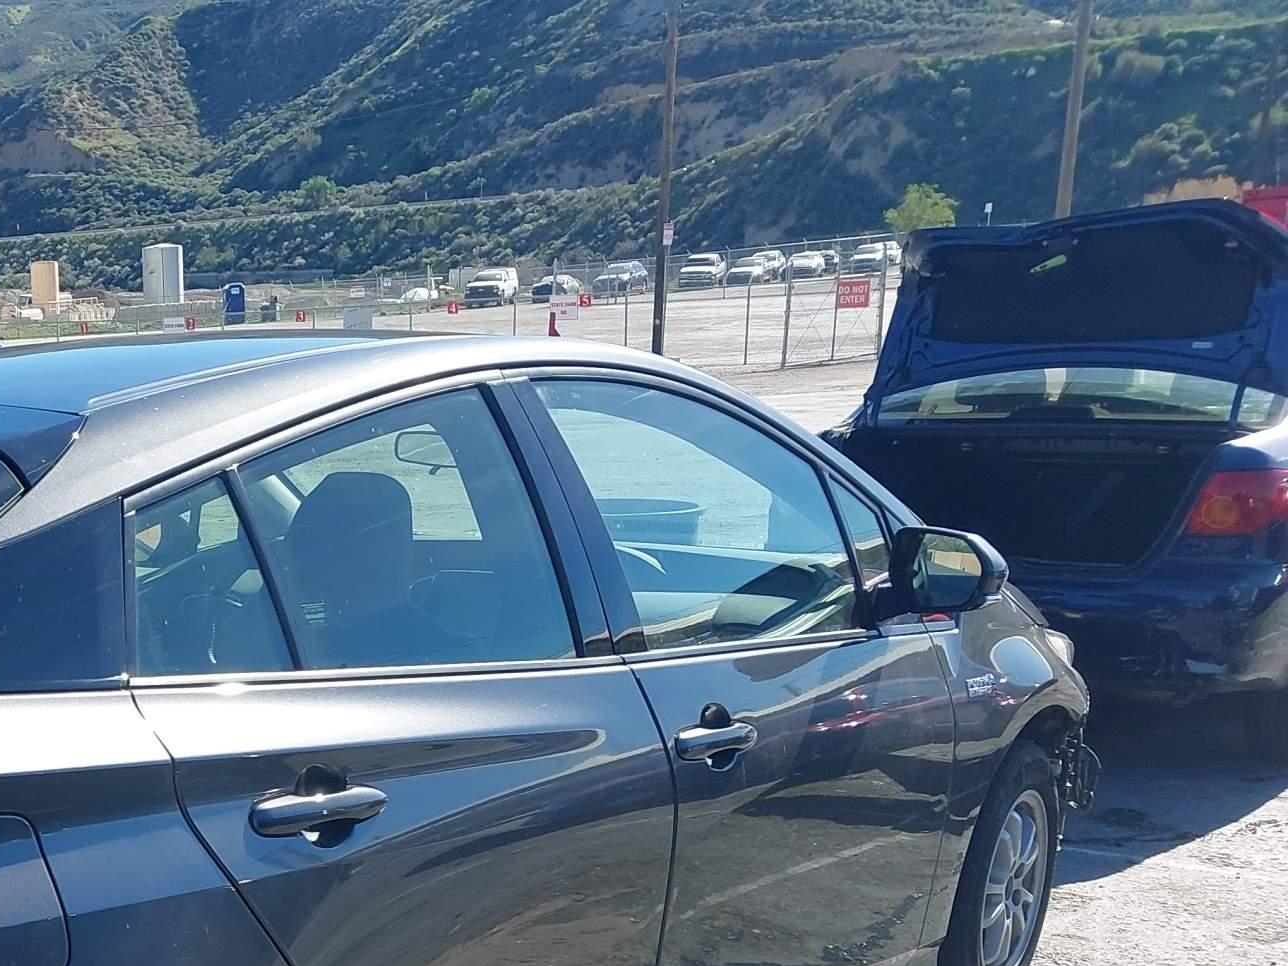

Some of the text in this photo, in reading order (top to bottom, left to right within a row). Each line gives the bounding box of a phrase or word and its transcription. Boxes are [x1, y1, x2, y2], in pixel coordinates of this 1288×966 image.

[838, 285, 868, 294] DO NOT
[839, 295, 865, 304] ENTER
